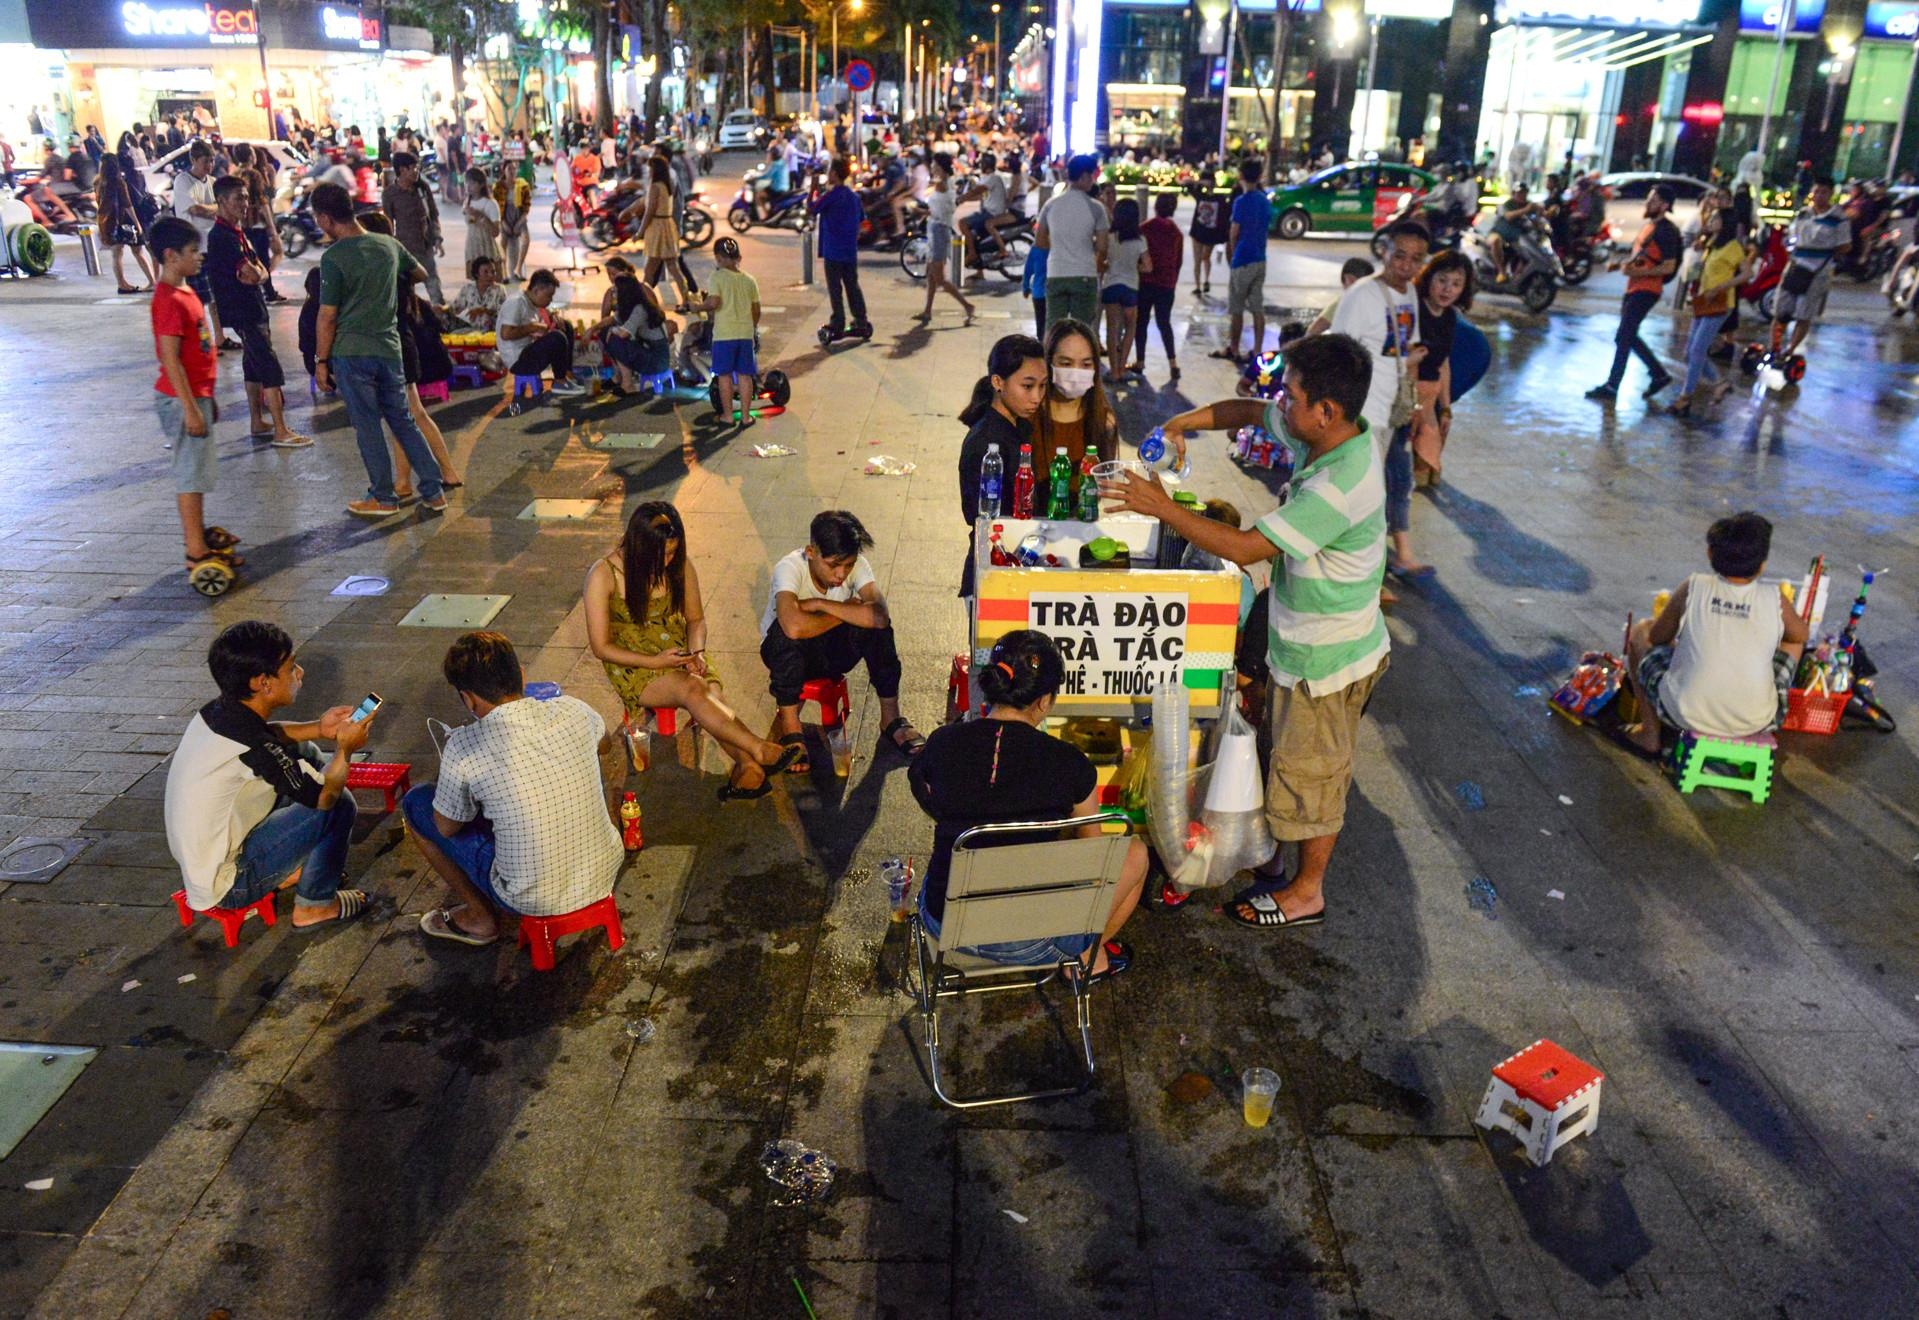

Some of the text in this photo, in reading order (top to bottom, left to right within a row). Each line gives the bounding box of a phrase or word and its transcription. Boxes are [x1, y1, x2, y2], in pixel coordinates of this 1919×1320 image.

[122, 1, 257, 34] Sharetea
[1032, 596, 1186, 627] TRÀ ĐÀO
[1051, 626, 1184, 661] RÀ TẮC
[1102, 661, 1155, 695] THUỐC
